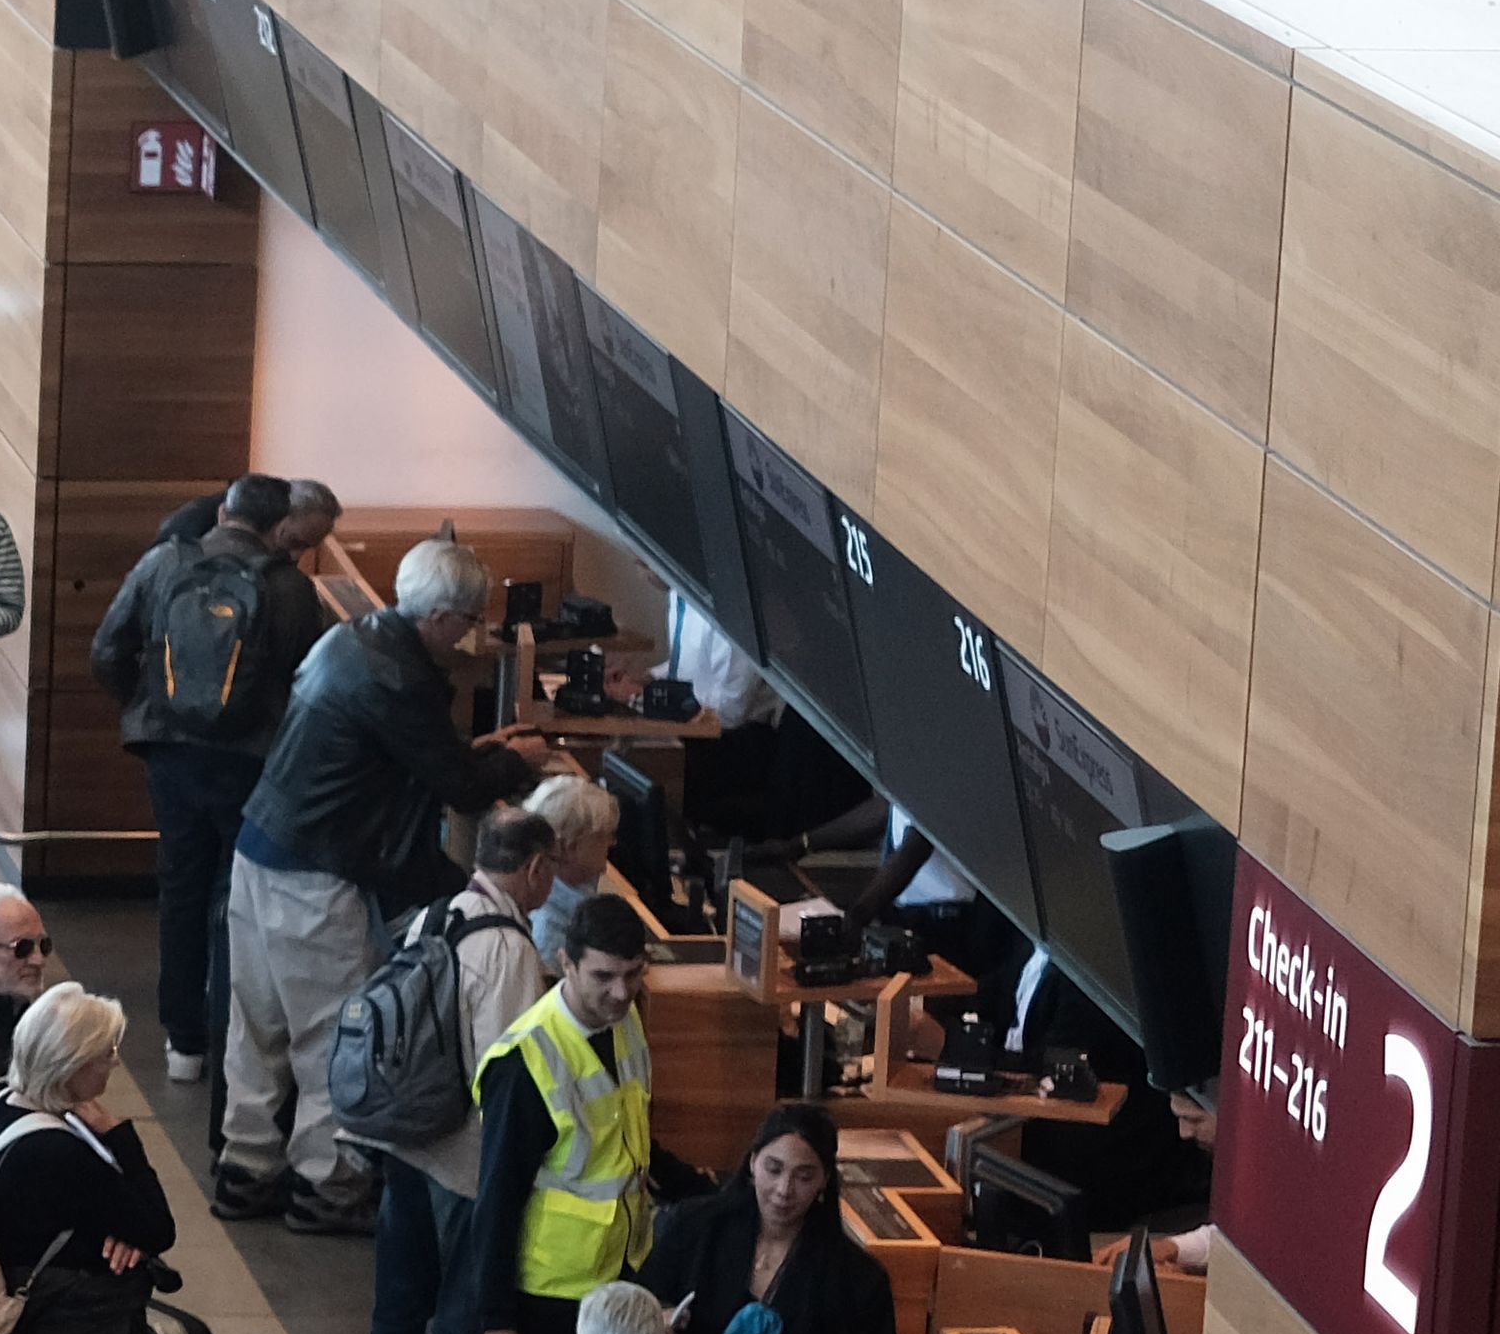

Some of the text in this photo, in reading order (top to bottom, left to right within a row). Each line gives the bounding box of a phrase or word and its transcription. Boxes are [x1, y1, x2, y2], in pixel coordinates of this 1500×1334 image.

[841, 515, 874, 586] 215
[953, 615, 992, 691] 216
[1248, 906, 1348, 1049] Check-in
